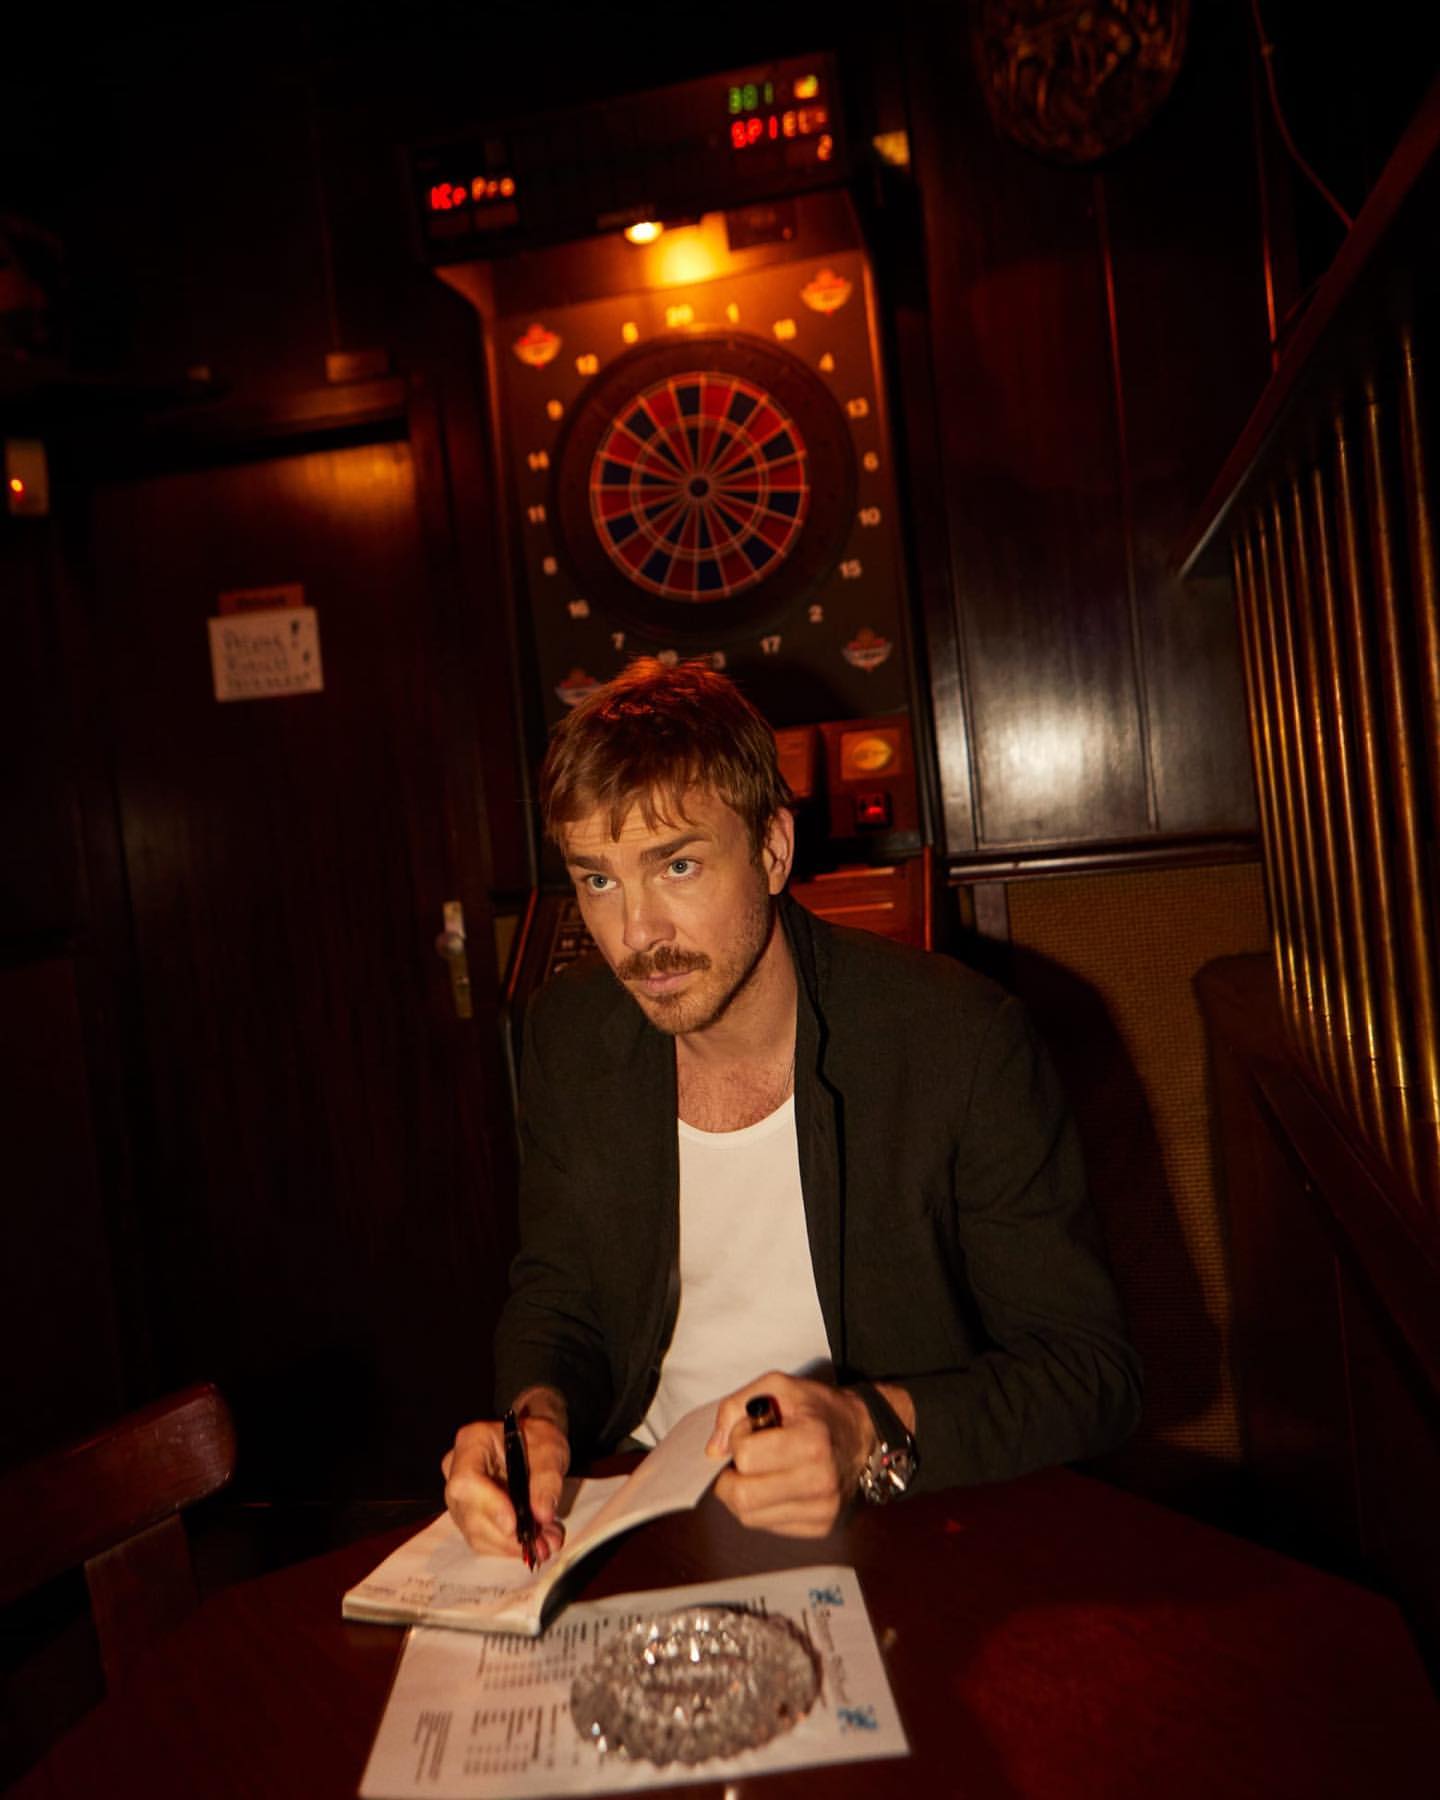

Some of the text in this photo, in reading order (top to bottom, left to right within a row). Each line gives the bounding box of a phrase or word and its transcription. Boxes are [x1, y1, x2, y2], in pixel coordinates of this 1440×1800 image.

[820, 354, 834, 371] 4
[528, 505, 545, 522] 11
[860, 508, 880, 525] 10
[840, 560, 861, 576] 15
[810, 606, 822, 622] 2
[613, 633, 624, 648] 7
[762, 636, 780, 652] 17
